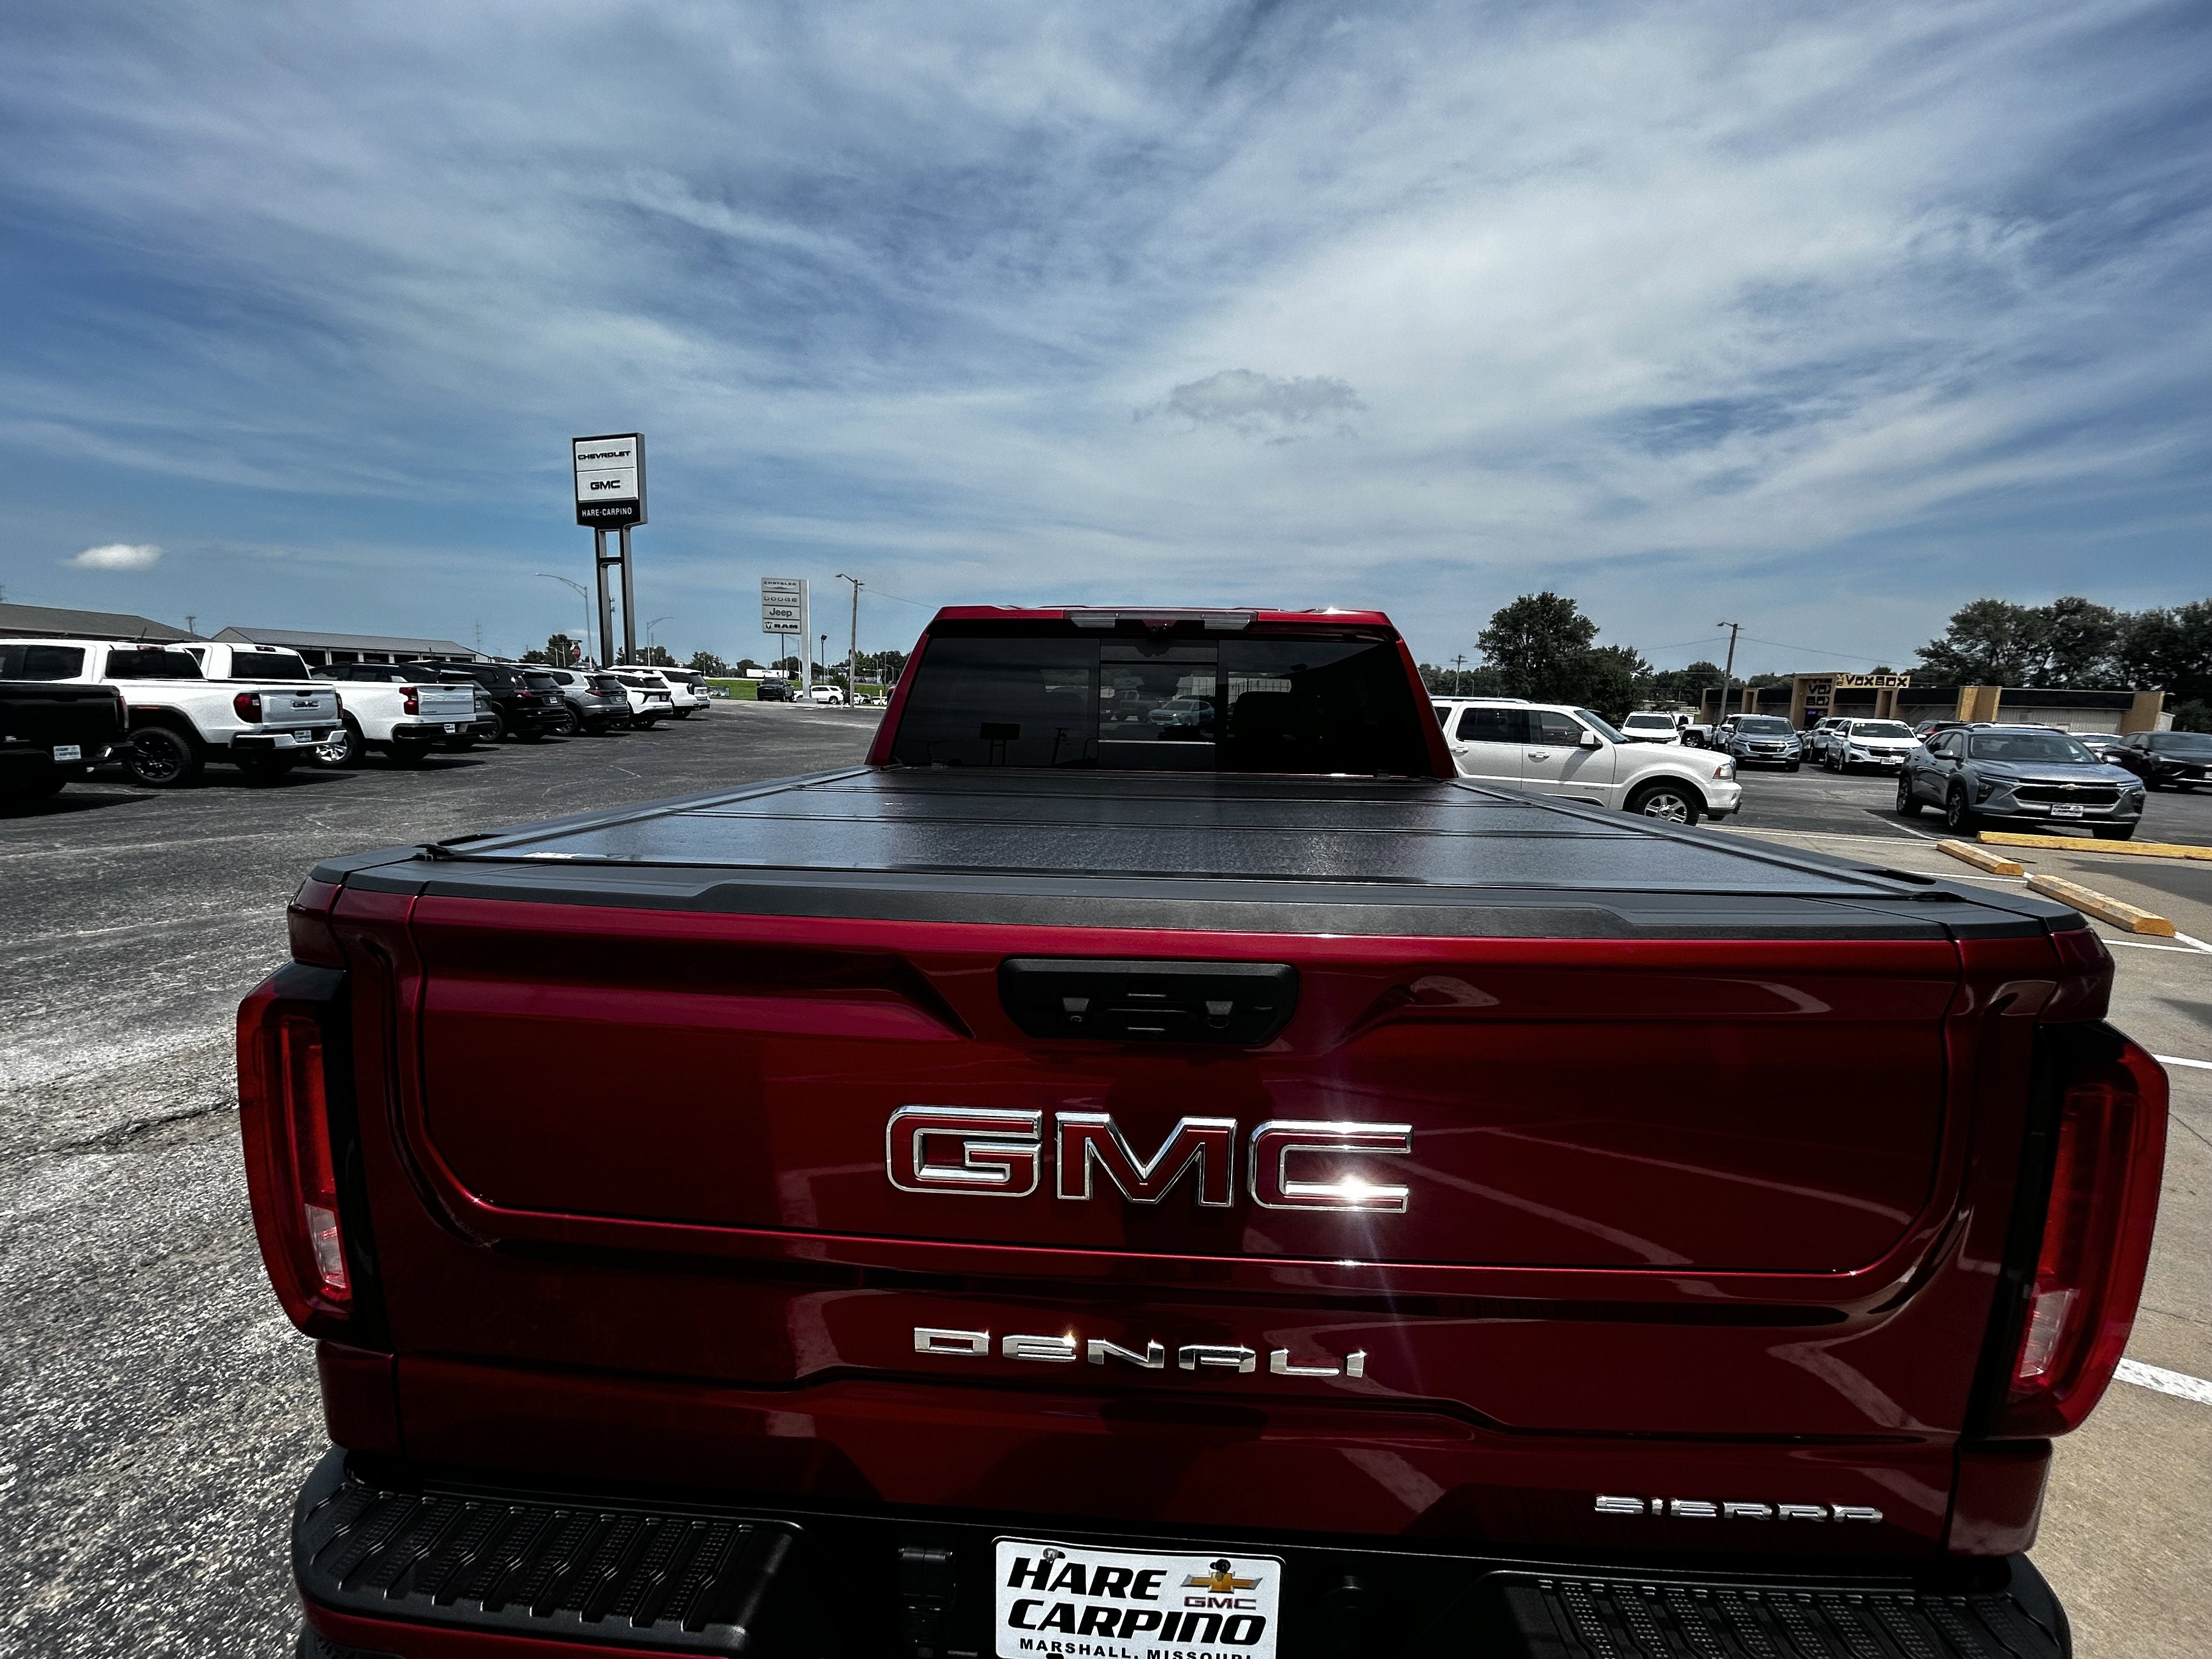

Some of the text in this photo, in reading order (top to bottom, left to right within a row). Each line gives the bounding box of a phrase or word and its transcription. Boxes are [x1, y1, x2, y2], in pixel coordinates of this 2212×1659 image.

[578, 450, 631, 460] CHEVROLET
[590, 480, 620, 490] GMC
[582, 507, 632, 517] HARE-CARPINO
[769, 607, 792, 618] Jeep
[885, 1104, 1413, 1214] GMC
[914, 1327, 1367, 1379] DENALI
[1594, 1494, 1883, 1523] SIERRA
[1007, 1556, 1167, 1601] HARE
[1184, 1596, 1257, 1611] GMC
[1007, 1598, 1267, 1646] CARPINO
[1020, 1638, 1139, 1659] MARSHALL,
